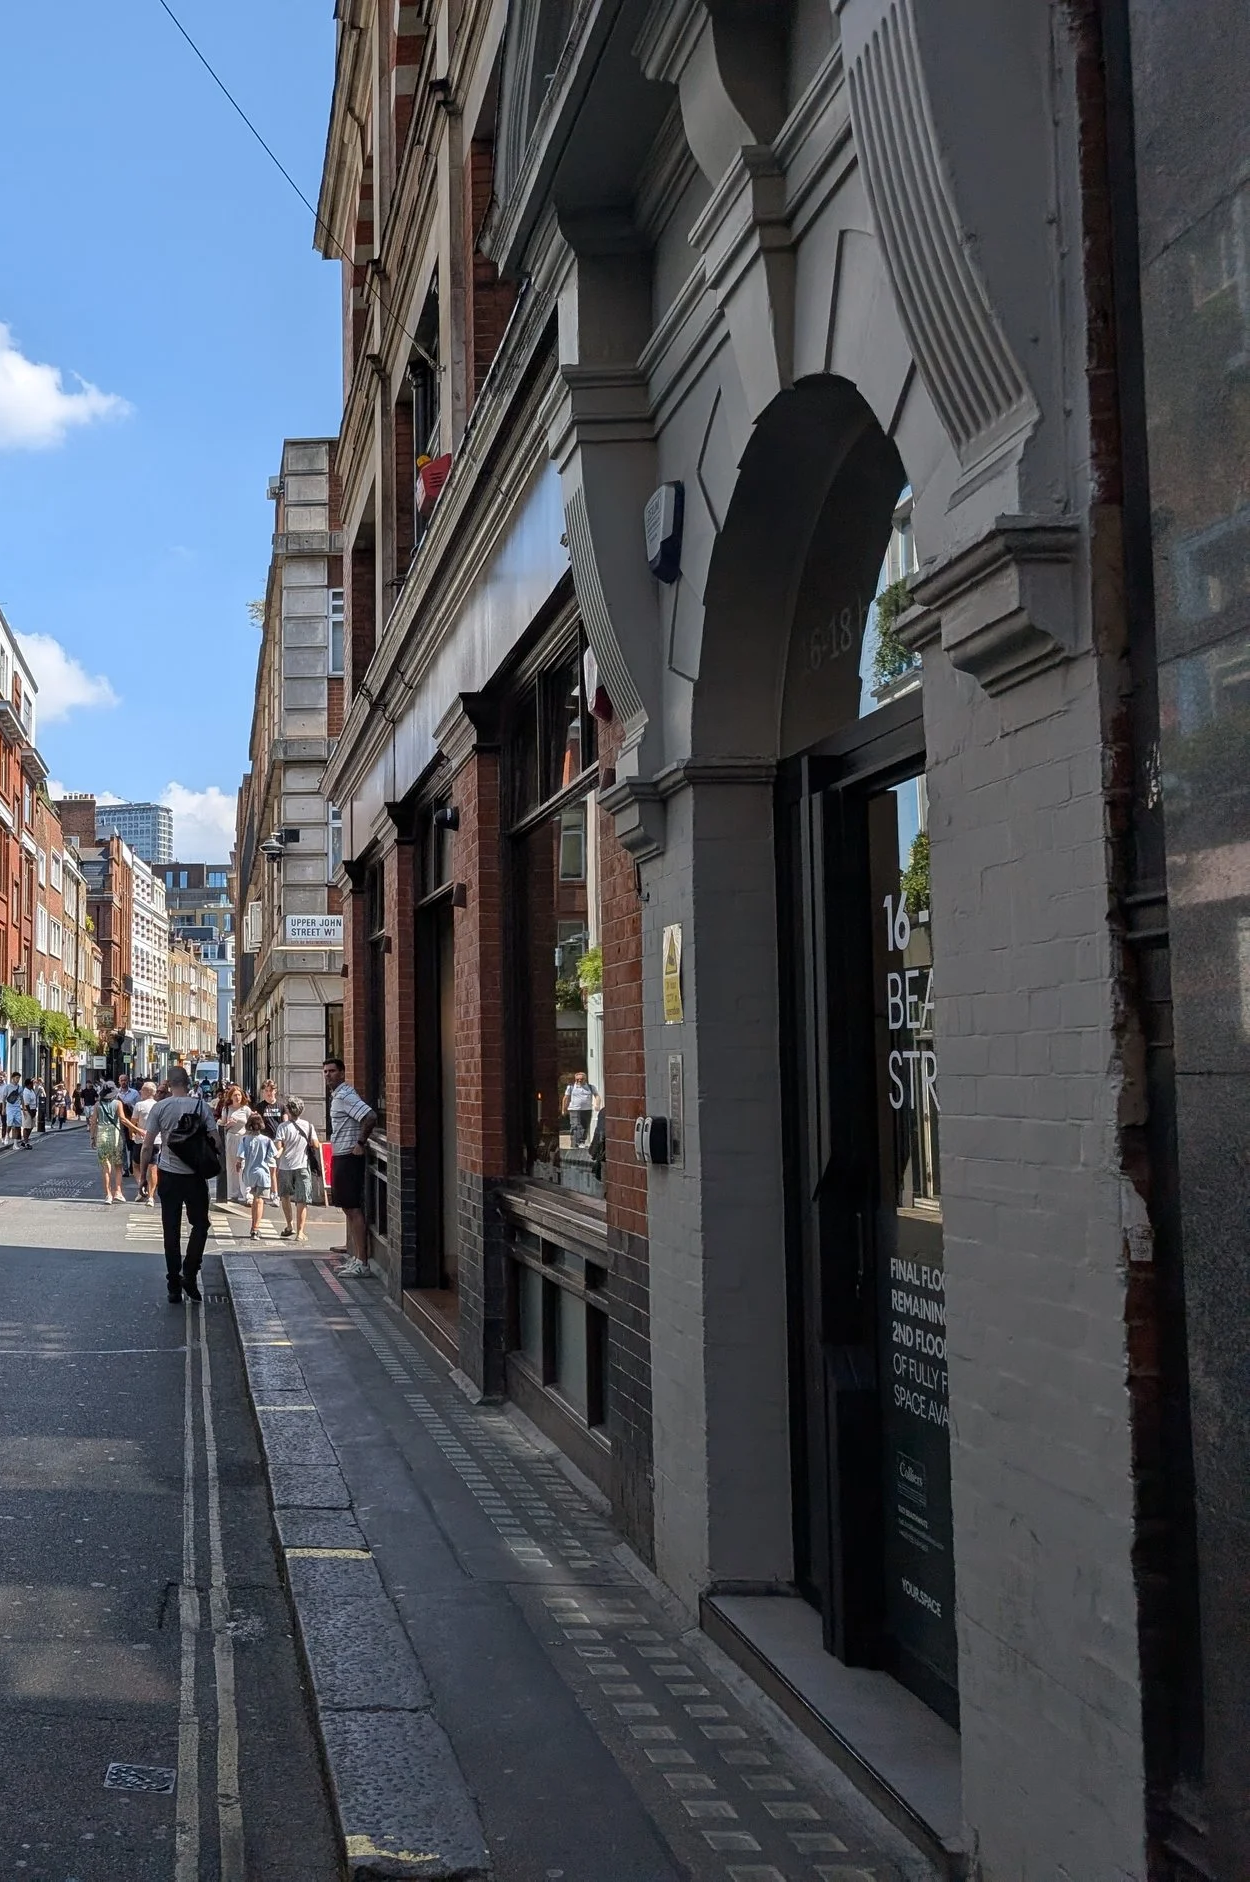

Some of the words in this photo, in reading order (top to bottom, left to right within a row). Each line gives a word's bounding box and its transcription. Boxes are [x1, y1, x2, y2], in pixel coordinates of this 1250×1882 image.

[291, 918, 316, 927] UPPER
[319, 918, 342, 927] JOHN
[291, 928, 320, 936] STREET
[323, 928, 336, 936] W1
[890, 1257, 920, 1287] FINAL
[892, 1320, 913, 1347] 2ND
[915, 1328, 948, 1361] FLOO
[893, 1352, 907, 1377] OF
[908, 1358, 939, 1391] FULLY
[894, 1383, 927, 1419] SPACE
